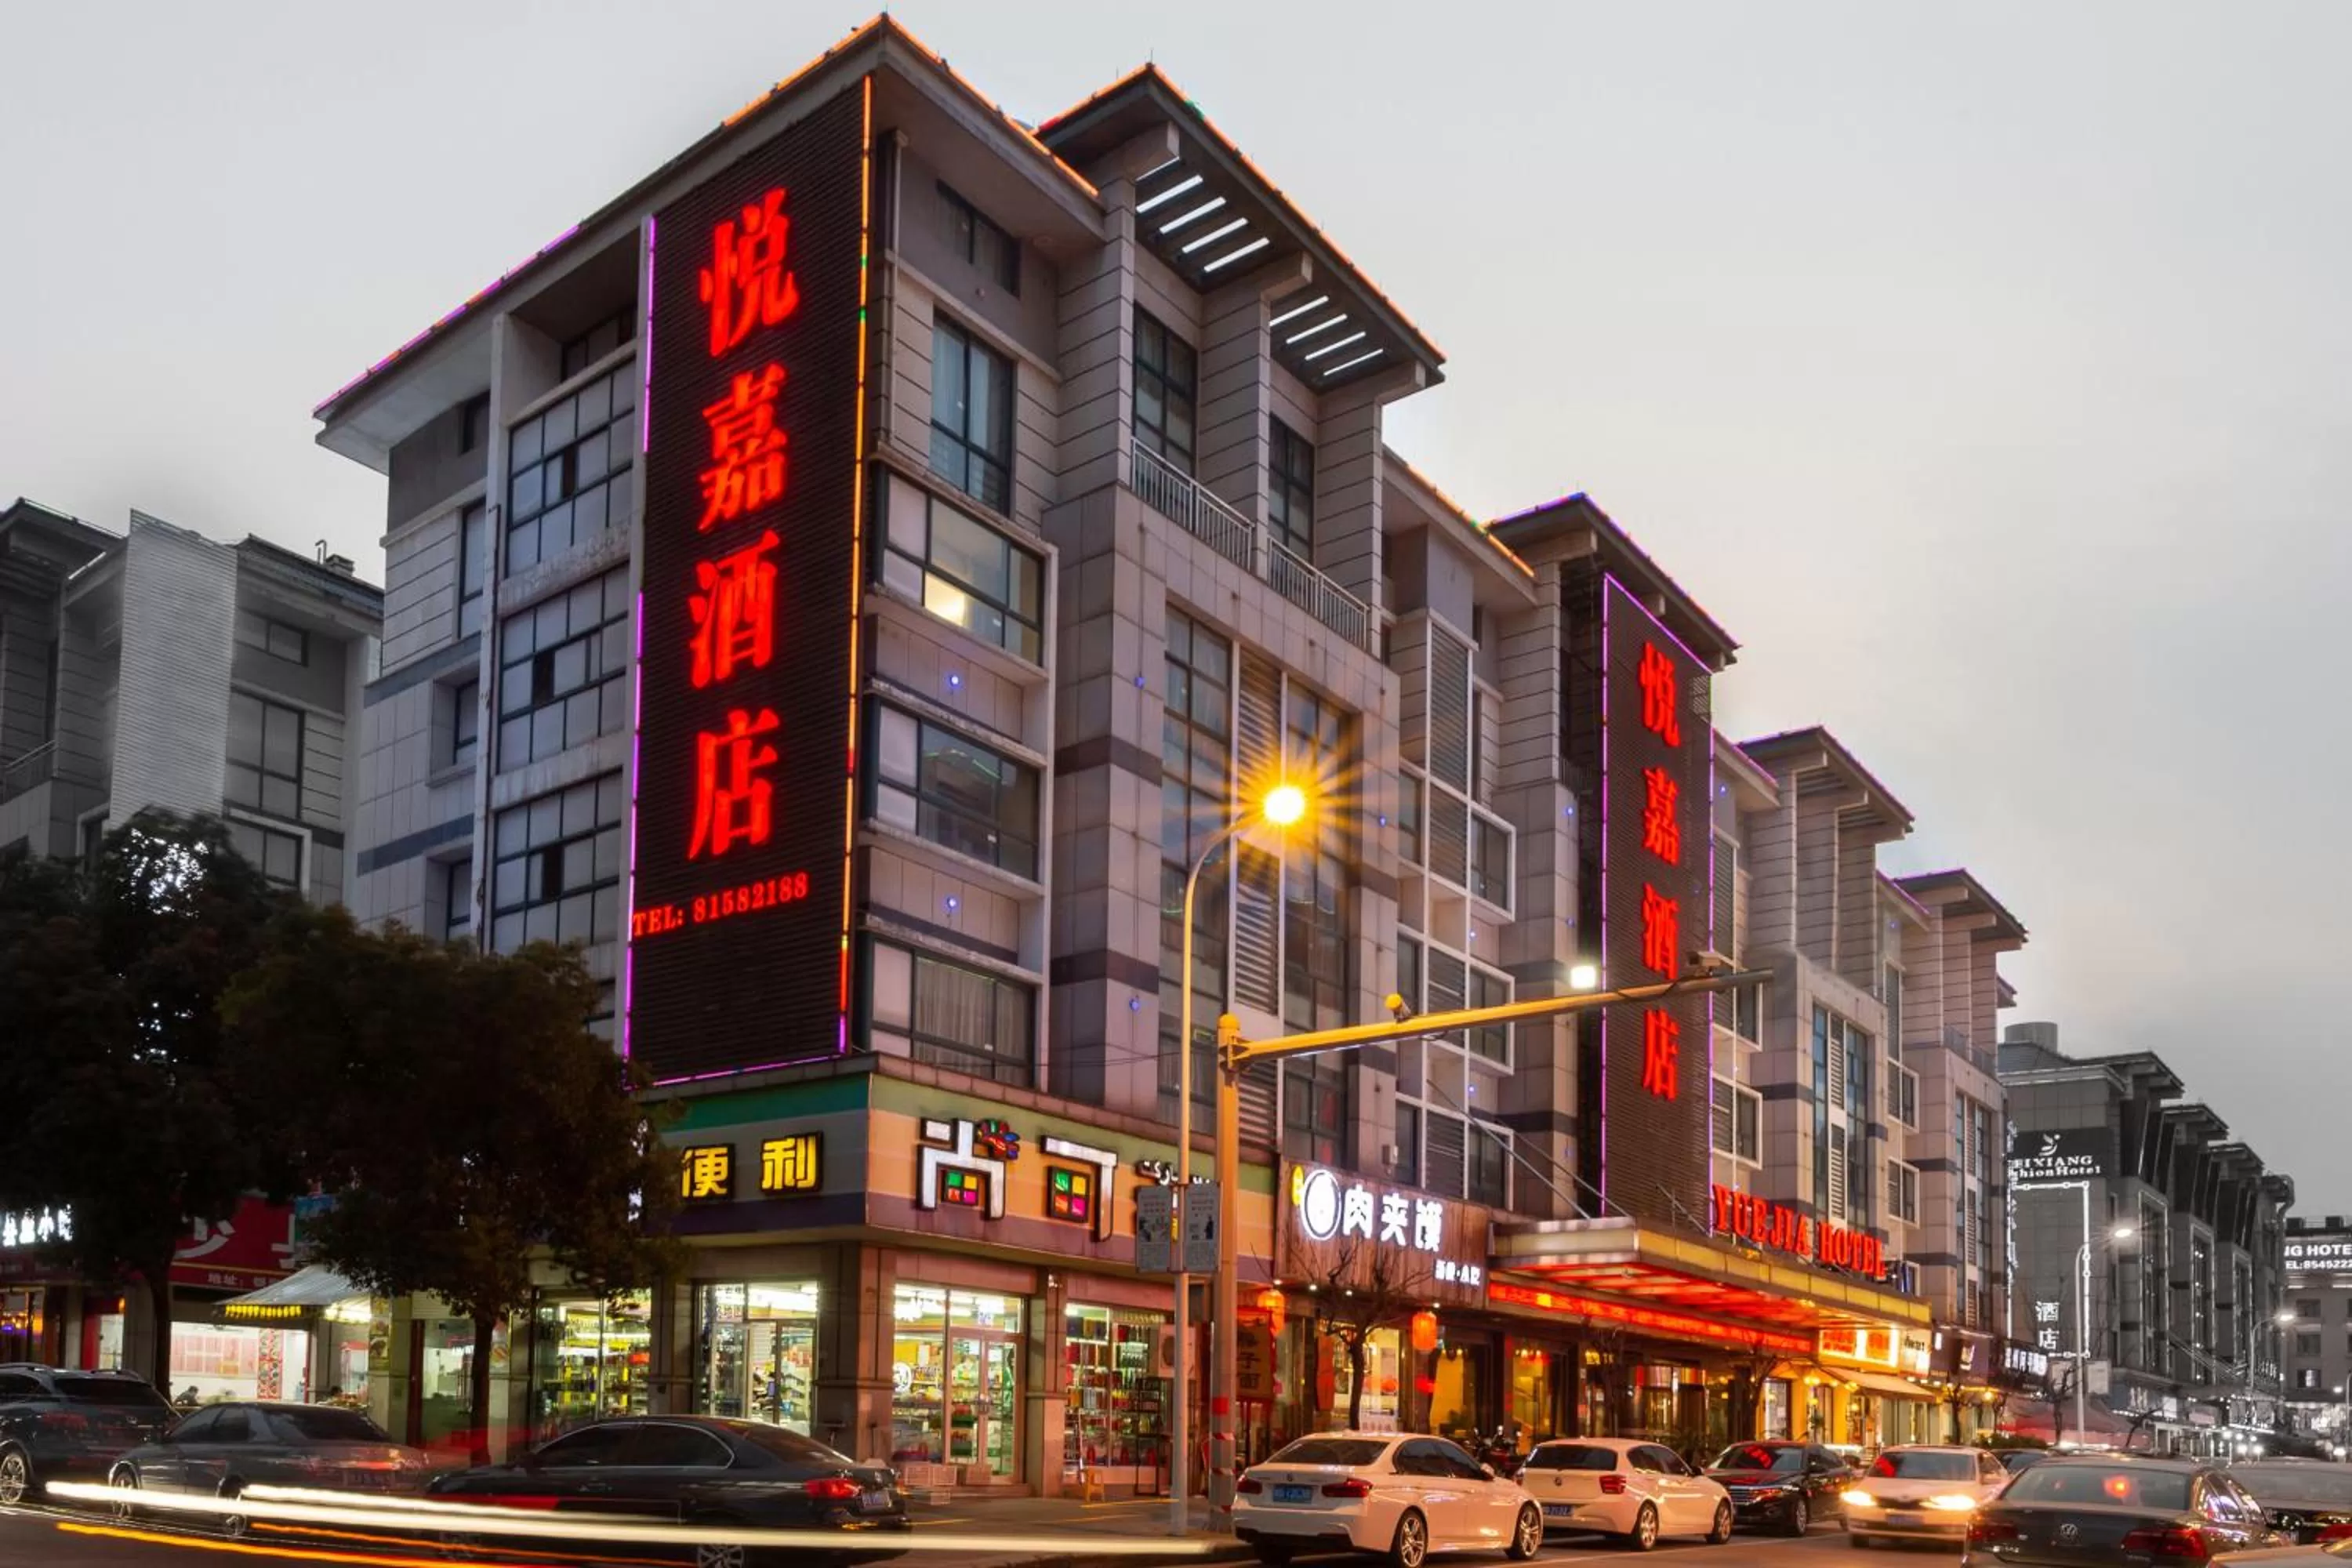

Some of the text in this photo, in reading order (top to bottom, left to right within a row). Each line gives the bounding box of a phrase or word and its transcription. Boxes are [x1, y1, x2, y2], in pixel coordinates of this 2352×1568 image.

[688, 188, 800, 859] 悦嘉酒店
[633, 871, 809, 936] TEL: 81582188
[1639, 642, 1679, 1101] 悦嘉酒店
[681, 1135, 817, 1197] 便利
[1712, 1183, 1887, 1279] YUEJIA HOTEL
[2035, 1301, 2060, 1349] 酒店
